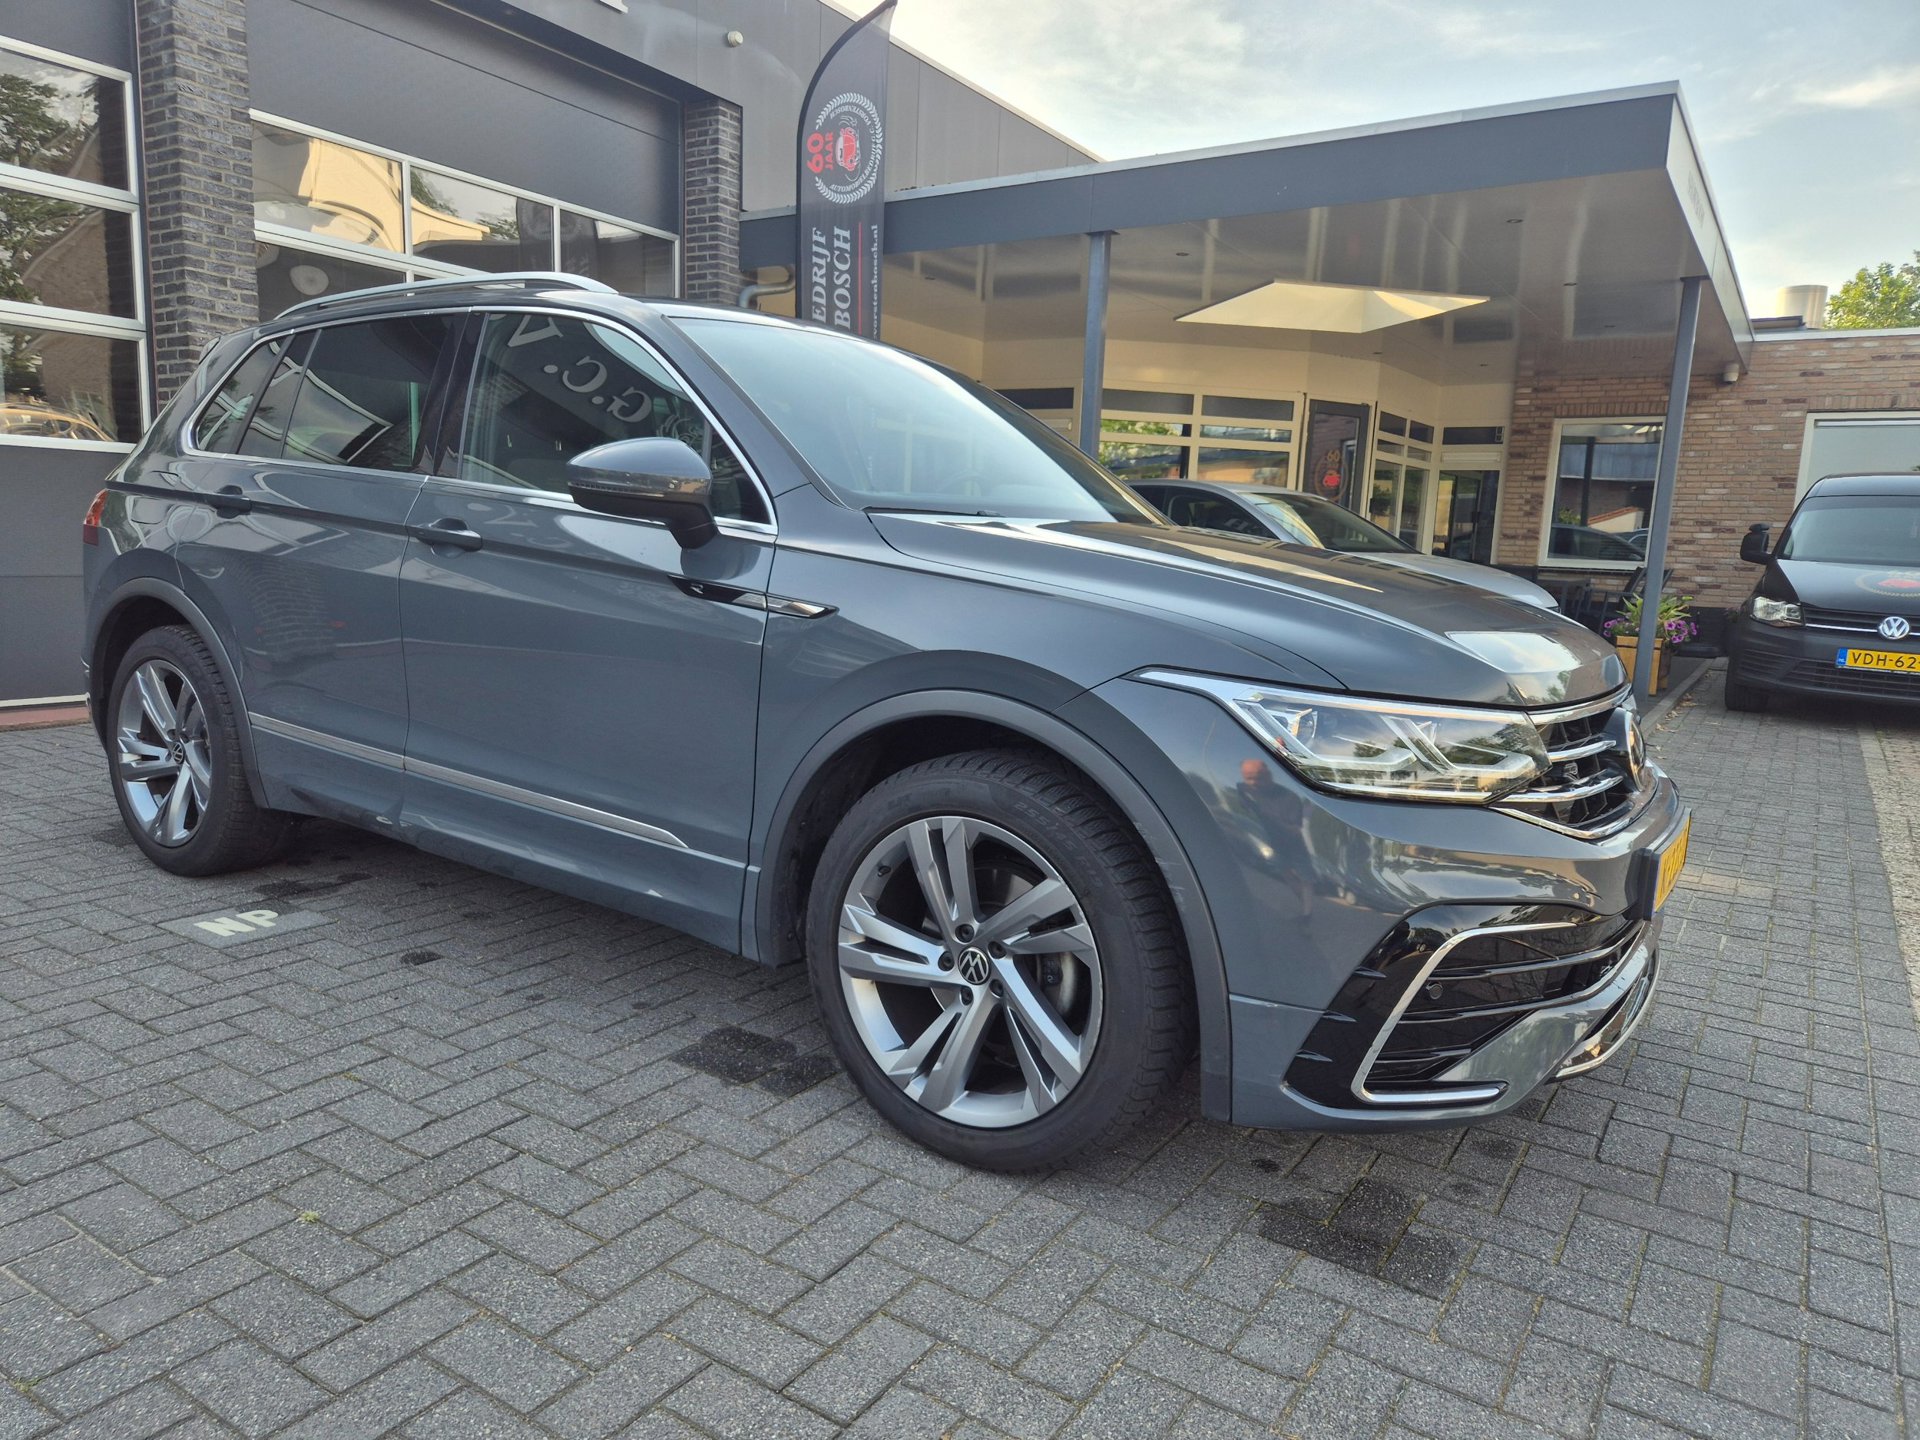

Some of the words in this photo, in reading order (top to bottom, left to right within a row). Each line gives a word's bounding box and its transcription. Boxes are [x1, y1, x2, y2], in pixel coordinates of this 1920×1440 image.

[806, 132, 825, 174] 60
[824, 131, 834, 171] JAAR
[811, 227, 831, 323] EDRIJF
[833, 226, 851, 329] BOSCH
[193, 909, 279, 937] NP
